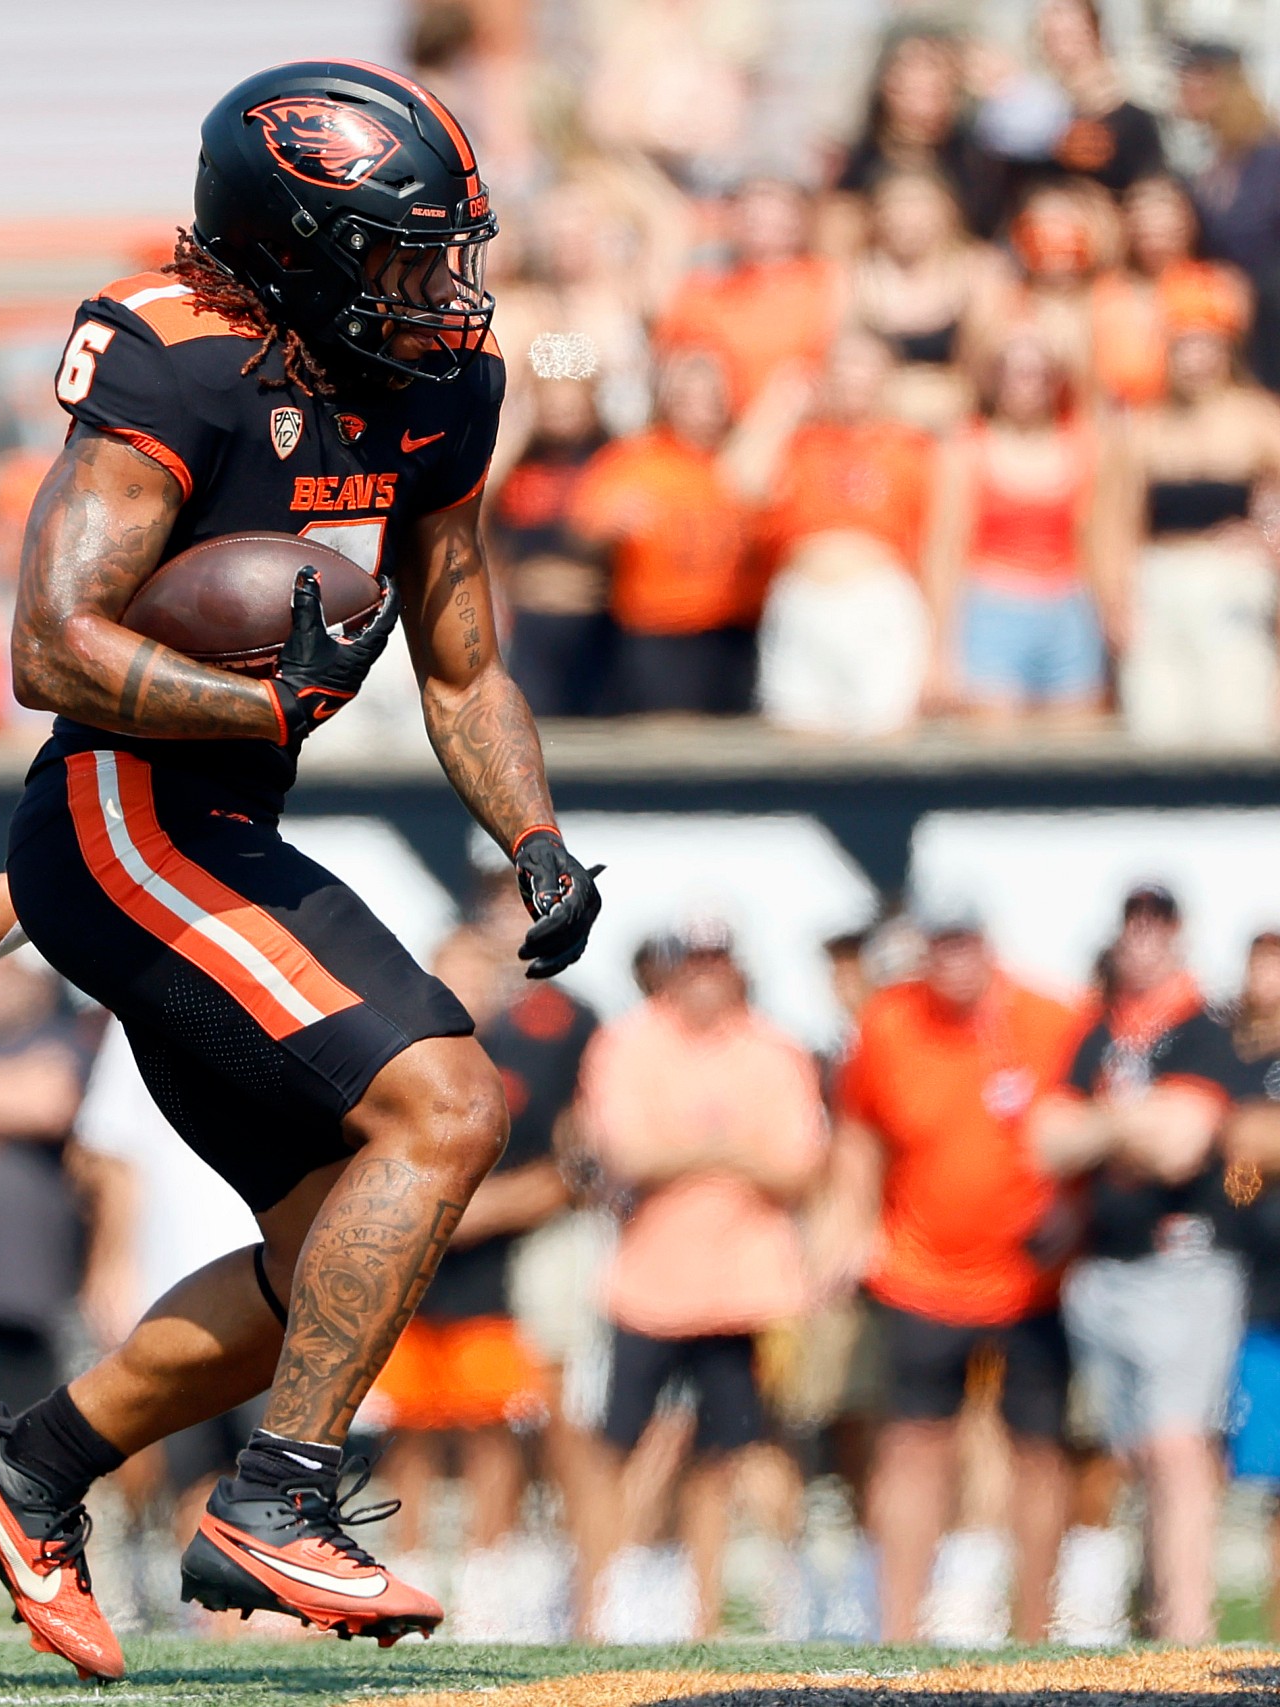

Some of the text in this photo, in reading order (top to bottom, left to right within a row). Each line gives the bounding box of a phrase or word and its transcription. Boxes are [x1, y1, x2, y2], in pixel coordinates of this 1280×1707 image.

[411, 207, 446, 218] BEAVERS
[55, 319, 115, 405] 6
[274, 409, 302, 438] PAC
[277, 430, 295, 448] 12
[290, 473, 398, 511] BEAVS
